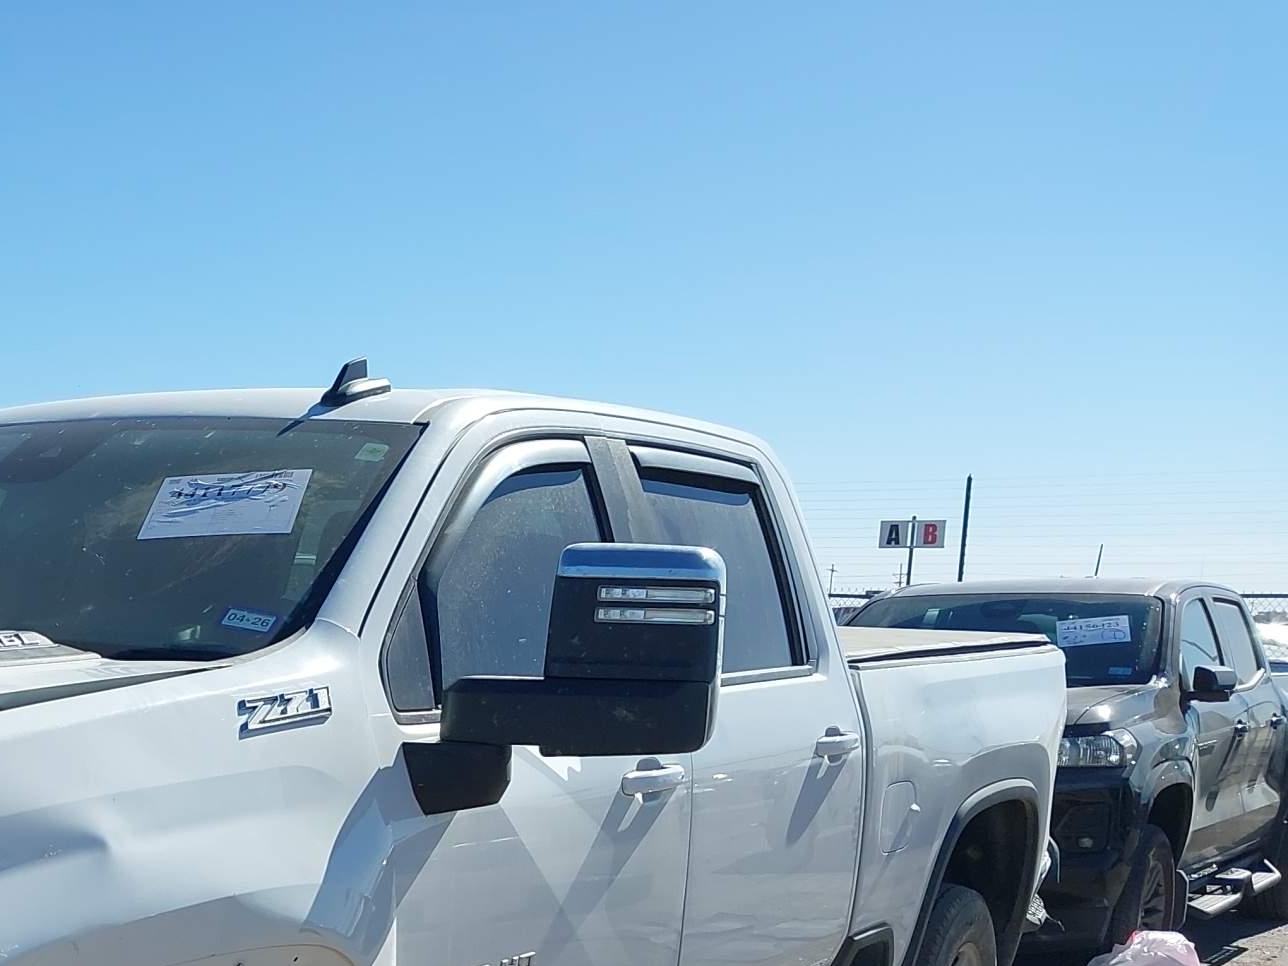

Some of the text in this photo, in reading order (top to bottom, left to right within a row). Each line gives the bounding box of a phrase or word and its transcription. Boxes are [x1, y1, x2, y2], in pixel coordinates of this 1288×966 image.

[885, 523, 901, 546] A
[923, 523, 938, 546] B
[236, 686, 332, 741] Z71
